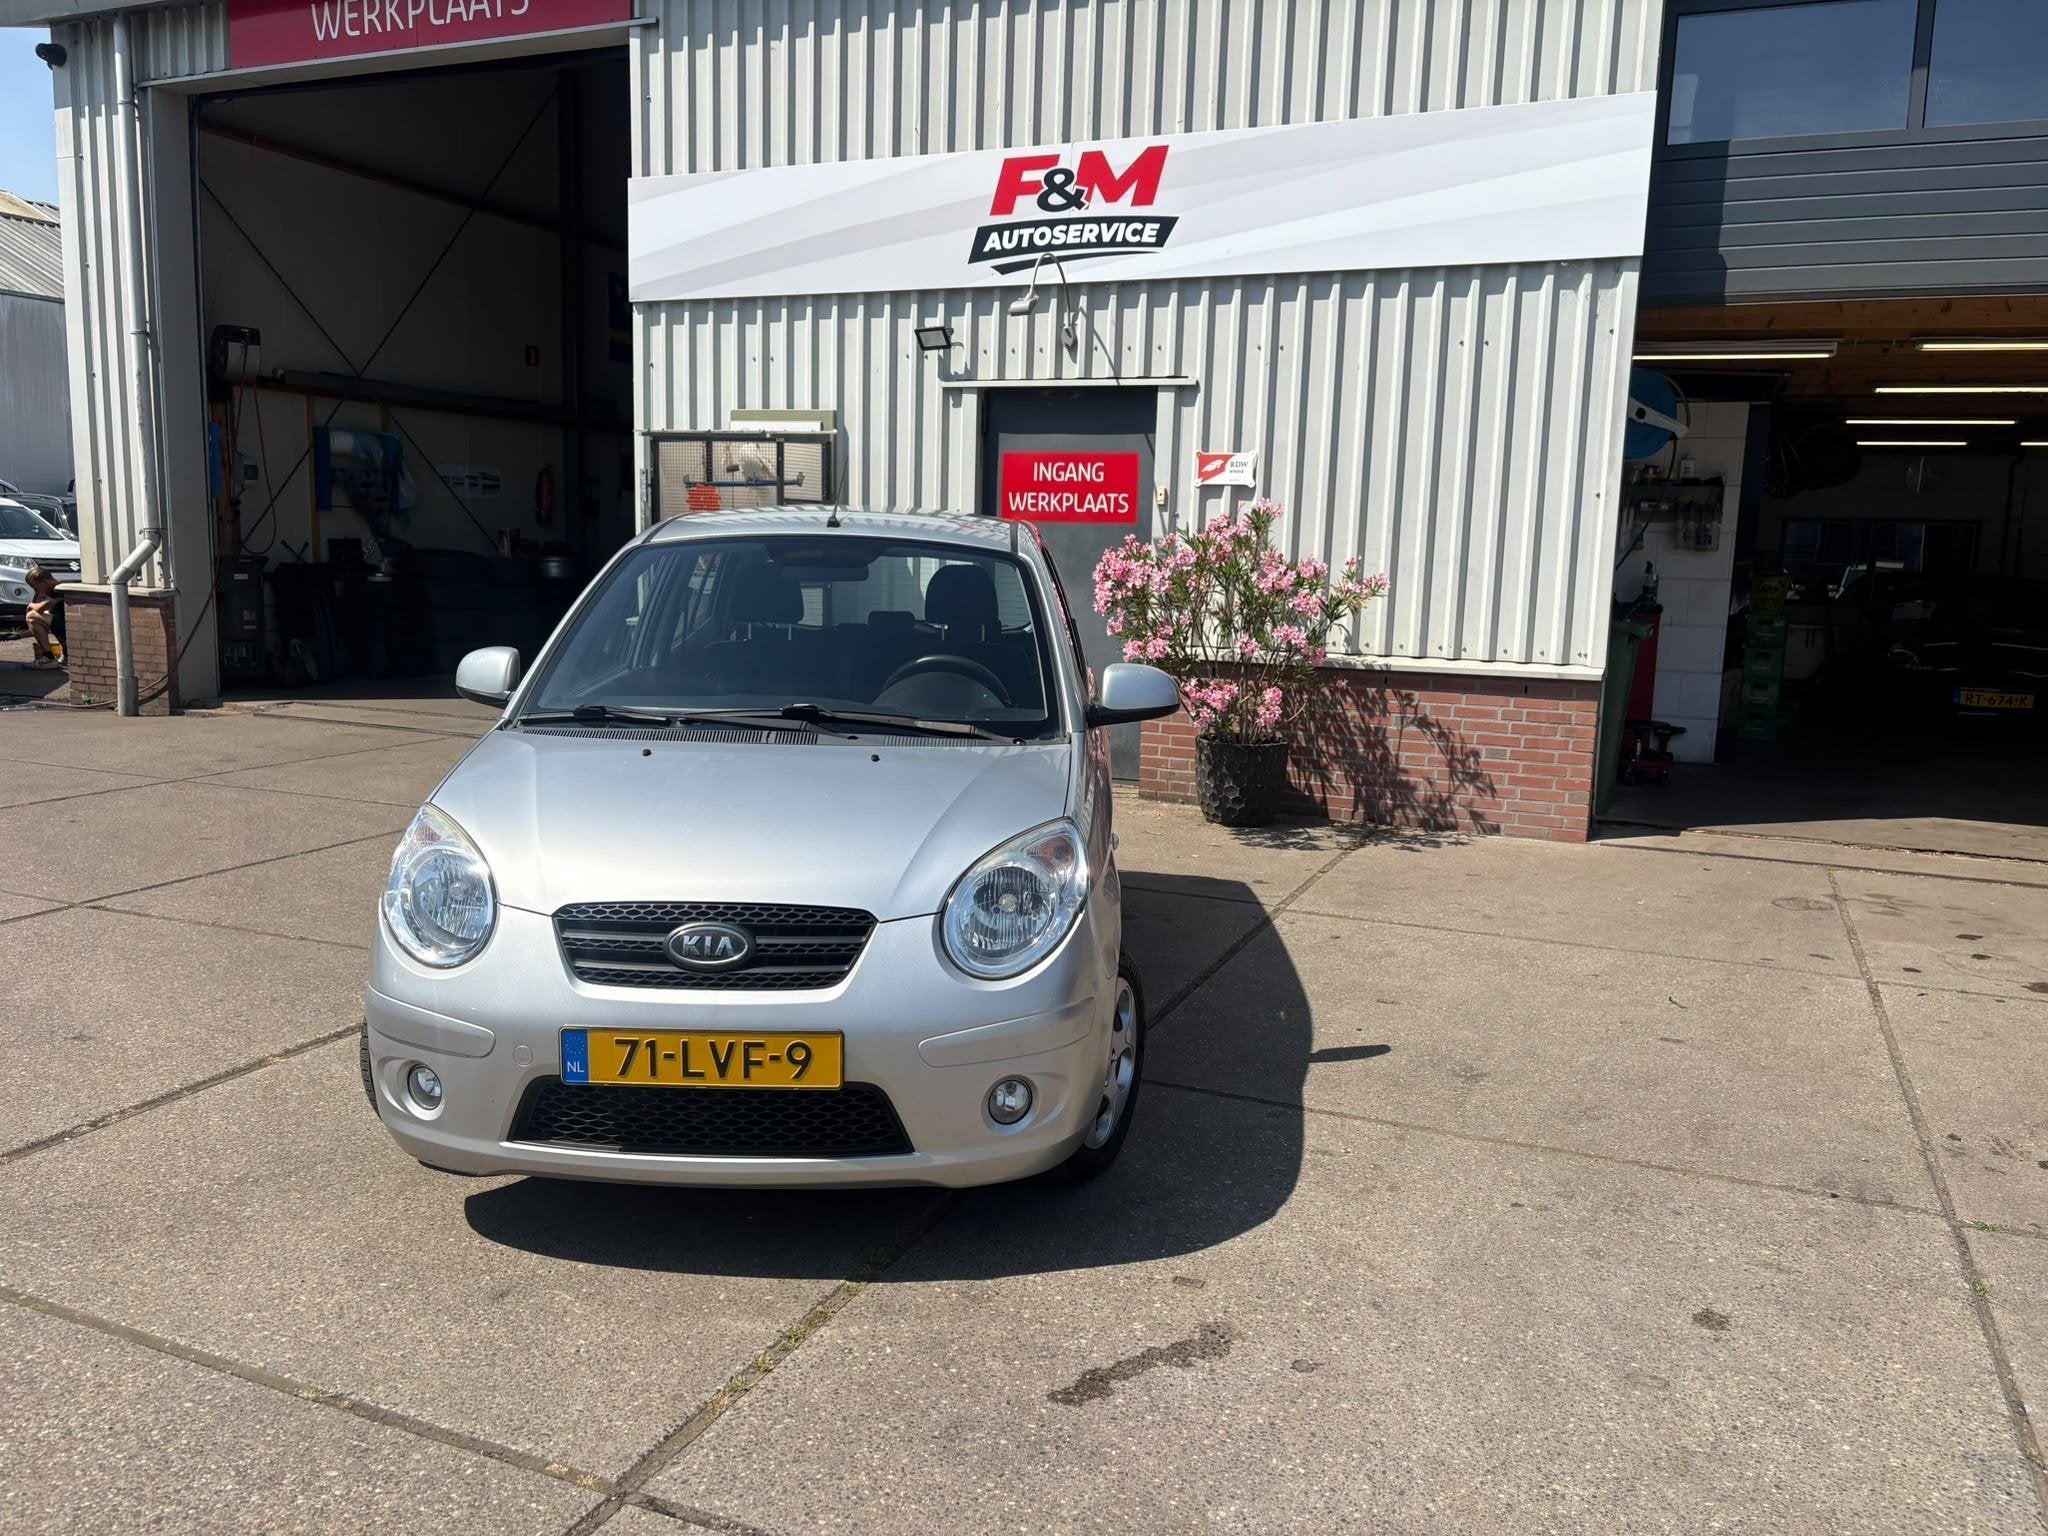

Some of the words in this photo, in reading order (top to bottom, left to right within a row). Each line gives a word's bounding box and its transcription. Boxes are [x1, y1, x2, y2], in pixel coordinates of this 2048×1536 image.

[989, 145, 1170, 216] F&M
[983, 222, 1161, 252] AUTOSERVICE
[1033, 462, 1105, 482] INGANG
[1008, 492, 1129, 513] WERKPLAATS
[1965, 693, 2028, 705] RT-674-K
[682, 933, 735, 957] KIA
[567, 1061, 585, 1073] NL
[613, 1036, 814, 1081] 71-LVF-9
